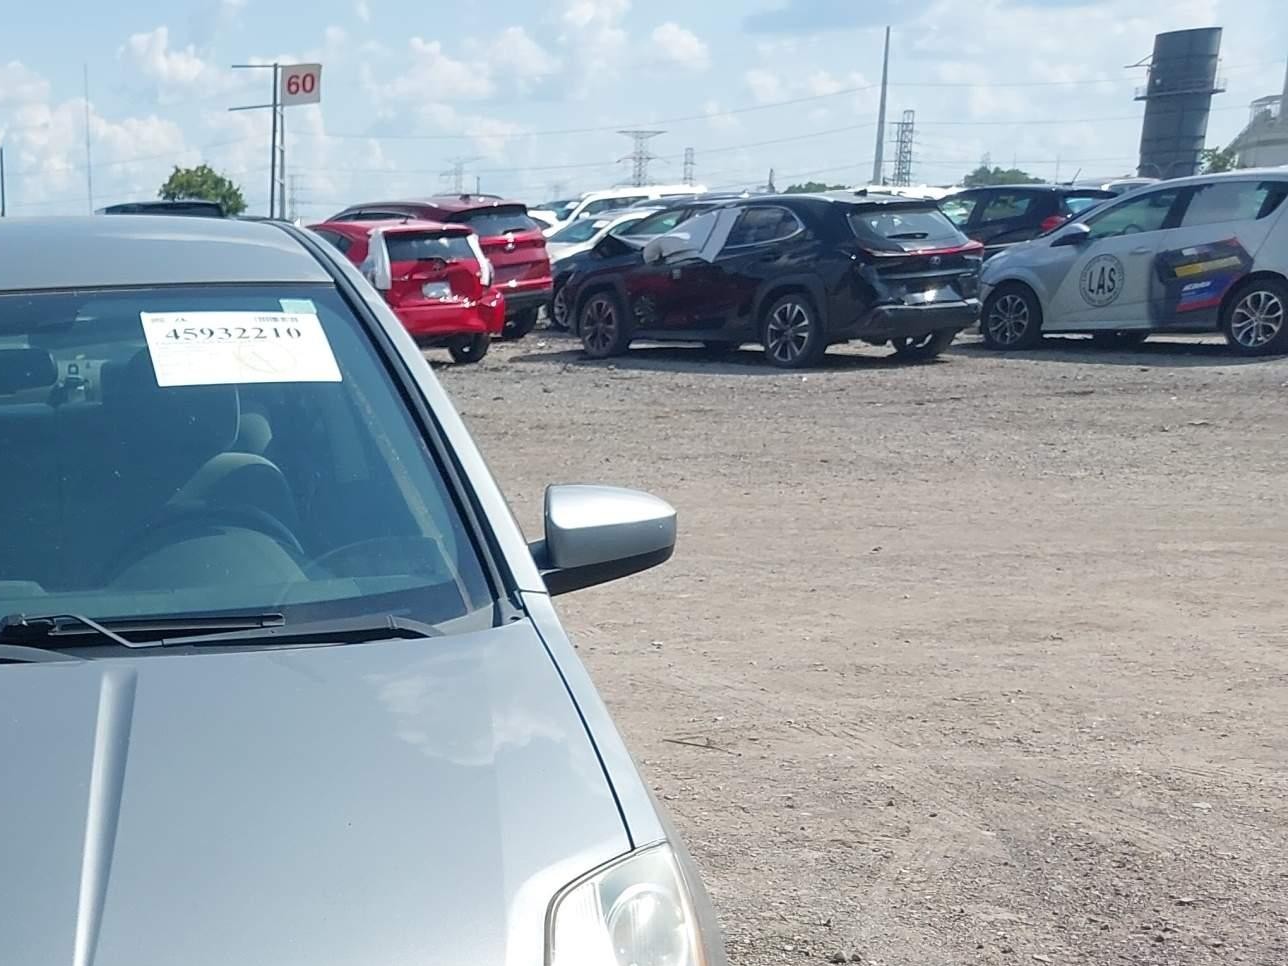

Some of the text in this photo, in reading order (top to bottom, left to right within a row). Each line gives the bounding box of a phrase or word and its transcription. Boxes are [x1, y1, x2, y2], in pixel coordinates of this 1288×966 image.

[287, 73, 316, 95] 60
[1088, 266, 1117, 295] LAS
[165, 326, 302, 341] 45932210
